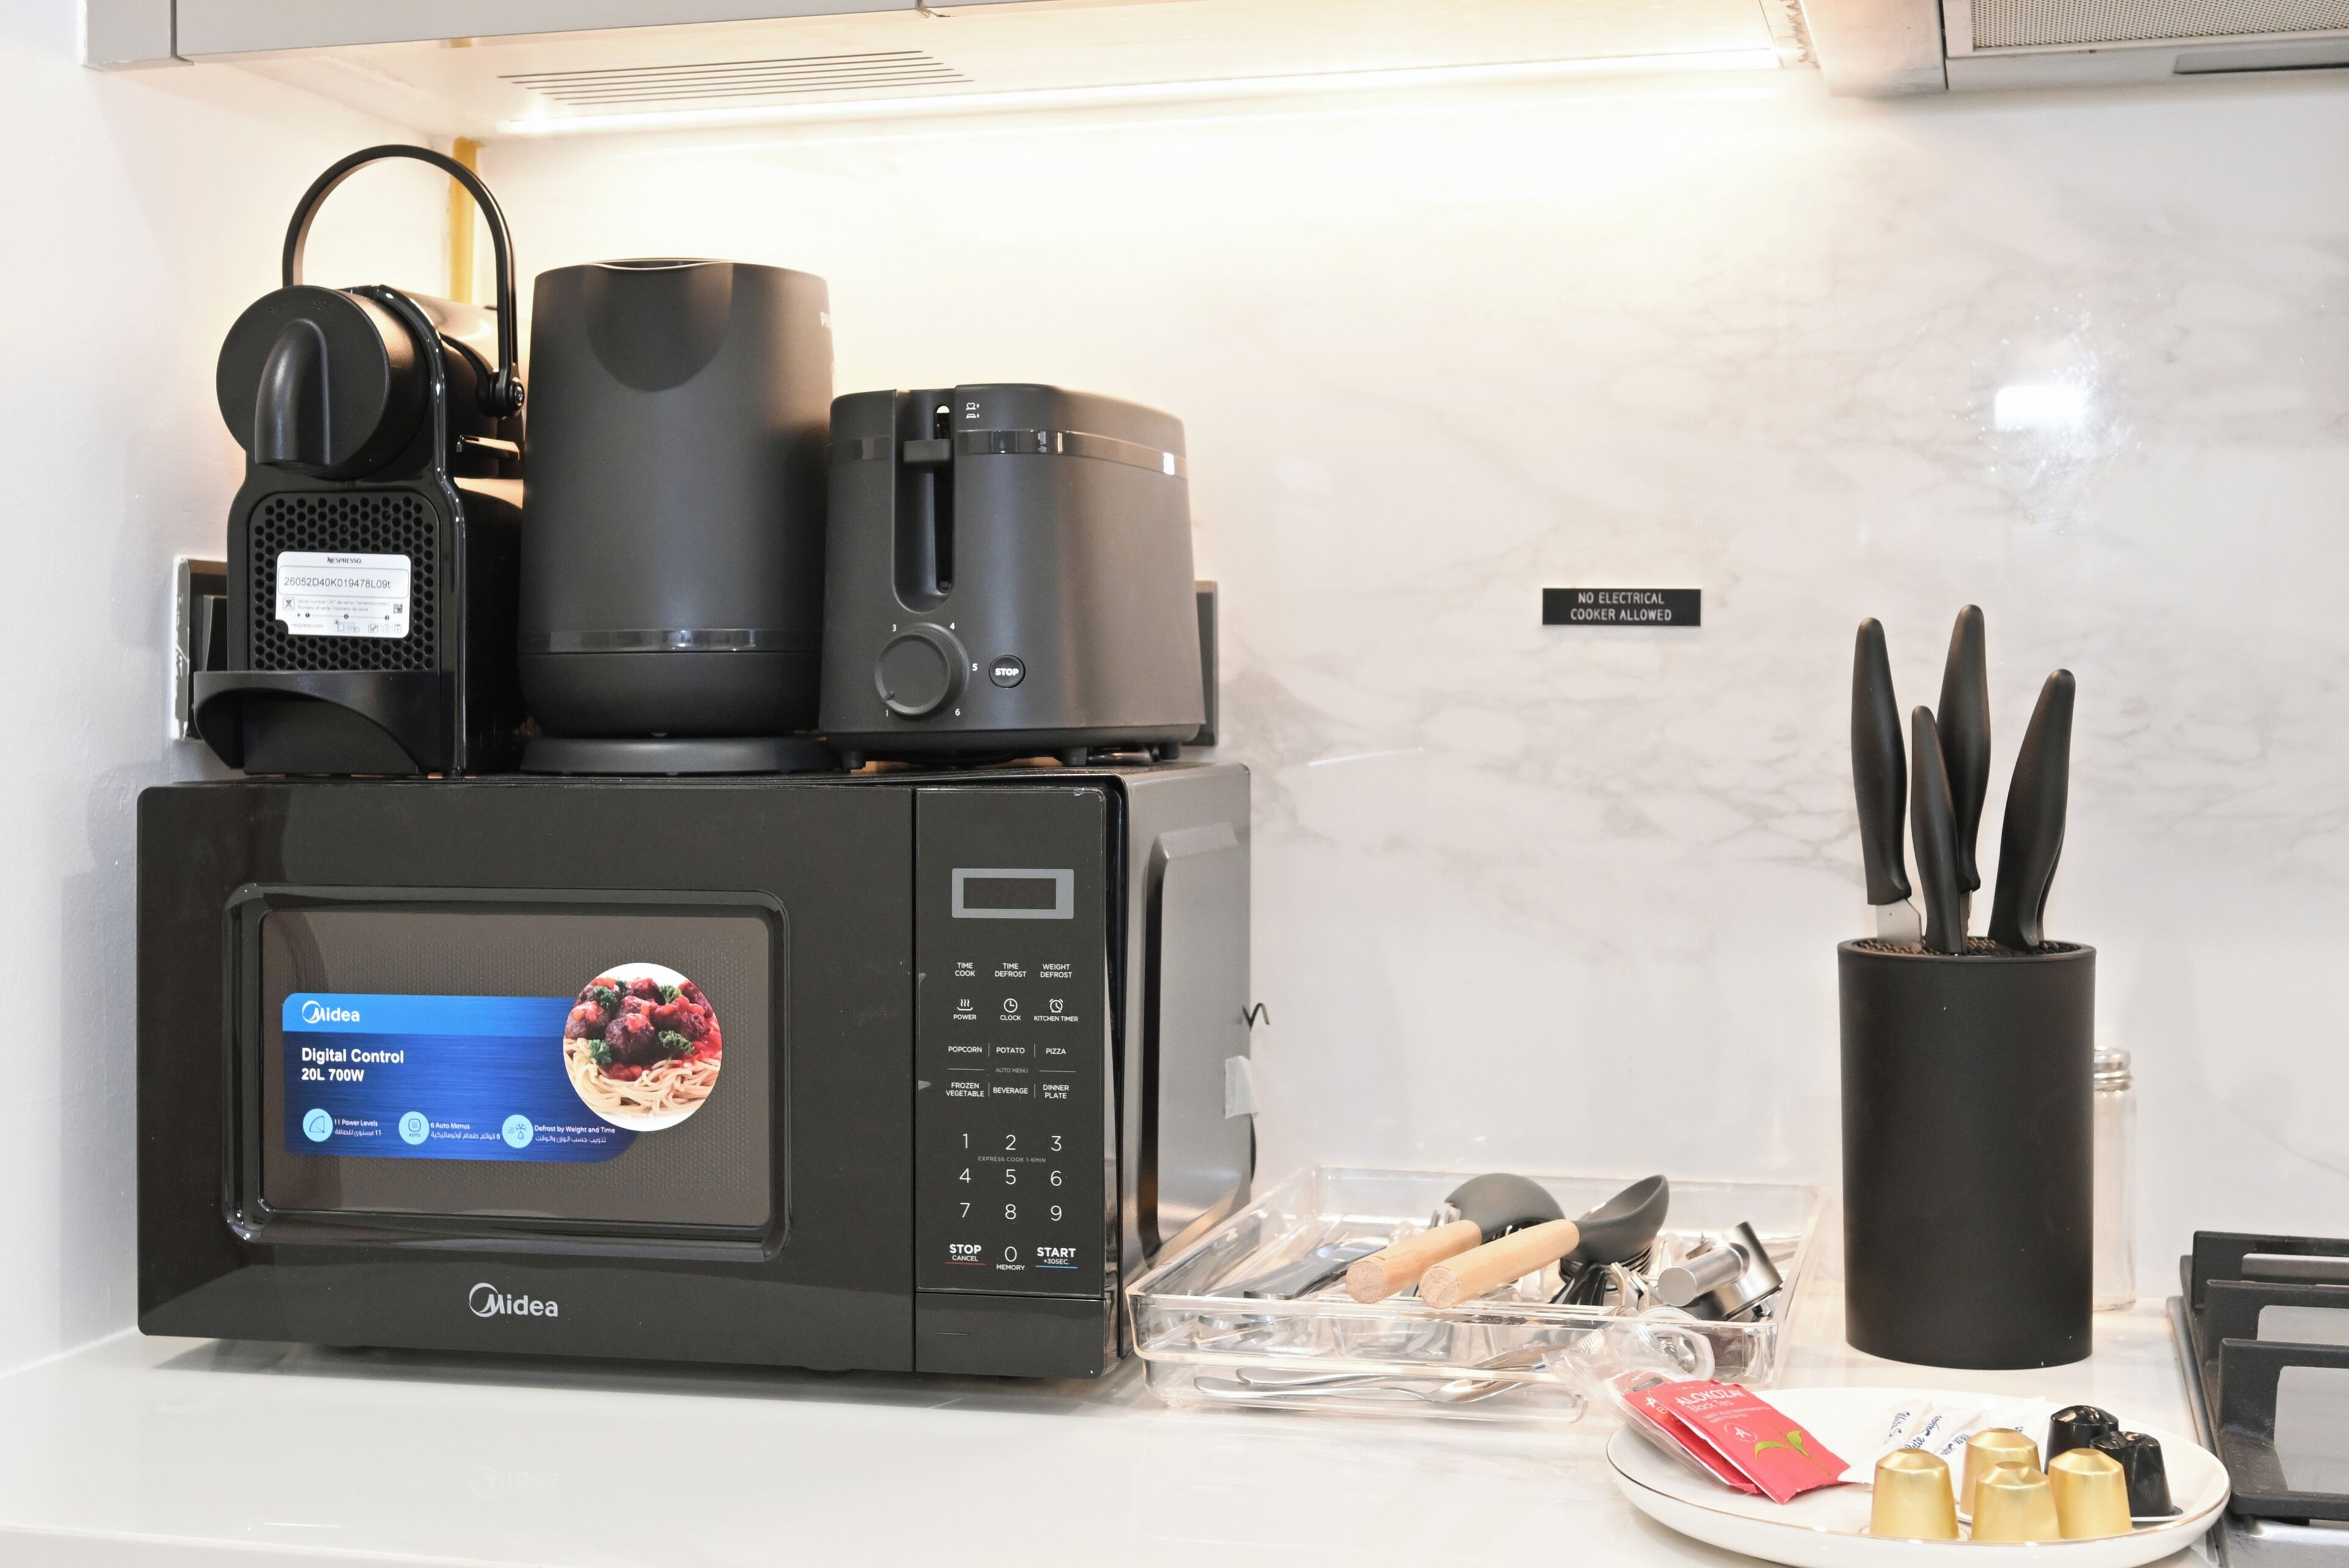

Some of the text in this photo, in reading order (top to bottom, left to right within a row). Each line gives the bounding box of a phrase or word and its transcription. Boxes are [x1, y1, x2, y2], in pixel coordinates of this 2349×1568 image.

[1578, 592, 1665, 605] NO ELECTRICAL
[1570, 608, 1672, 621] COOKER ALLOWED
[971, 663, 978, 671] 5
[995, 668, 1020, 676] STOP
[302, 1000, 360, 1024] Midea
[301, 1047, 404, 1065] Digital Control
[301, 1068, 365, 1082] 20L 700W
[557, 1125, 565, 1134] by
[565, 1126, 587, 1134] Weight
[962, 1133, 968, 1149] 1
[1004, 1134, 1017, 1151] 2
[1050, 1135, 1062, 1152] 3
[959, 1167, 971, 1183] 4
[1005, 1169, 1016, 1185] 5
[1050, 1170, 1062, 1186] 6
[959, 1202, 971, 1218] 7
[1004, 1204, 1017, 1220] 8
[1050, 1205, 1063, 1221] 9
[949, 1243, 982, 1254] STOP
[1004, 1246, 1017, 1262] 0
[1036, 1246, 1077, 1258] START
[469, 1282, 558, 1318] Midea
[1686, 1401, 1716, 1413] Black
